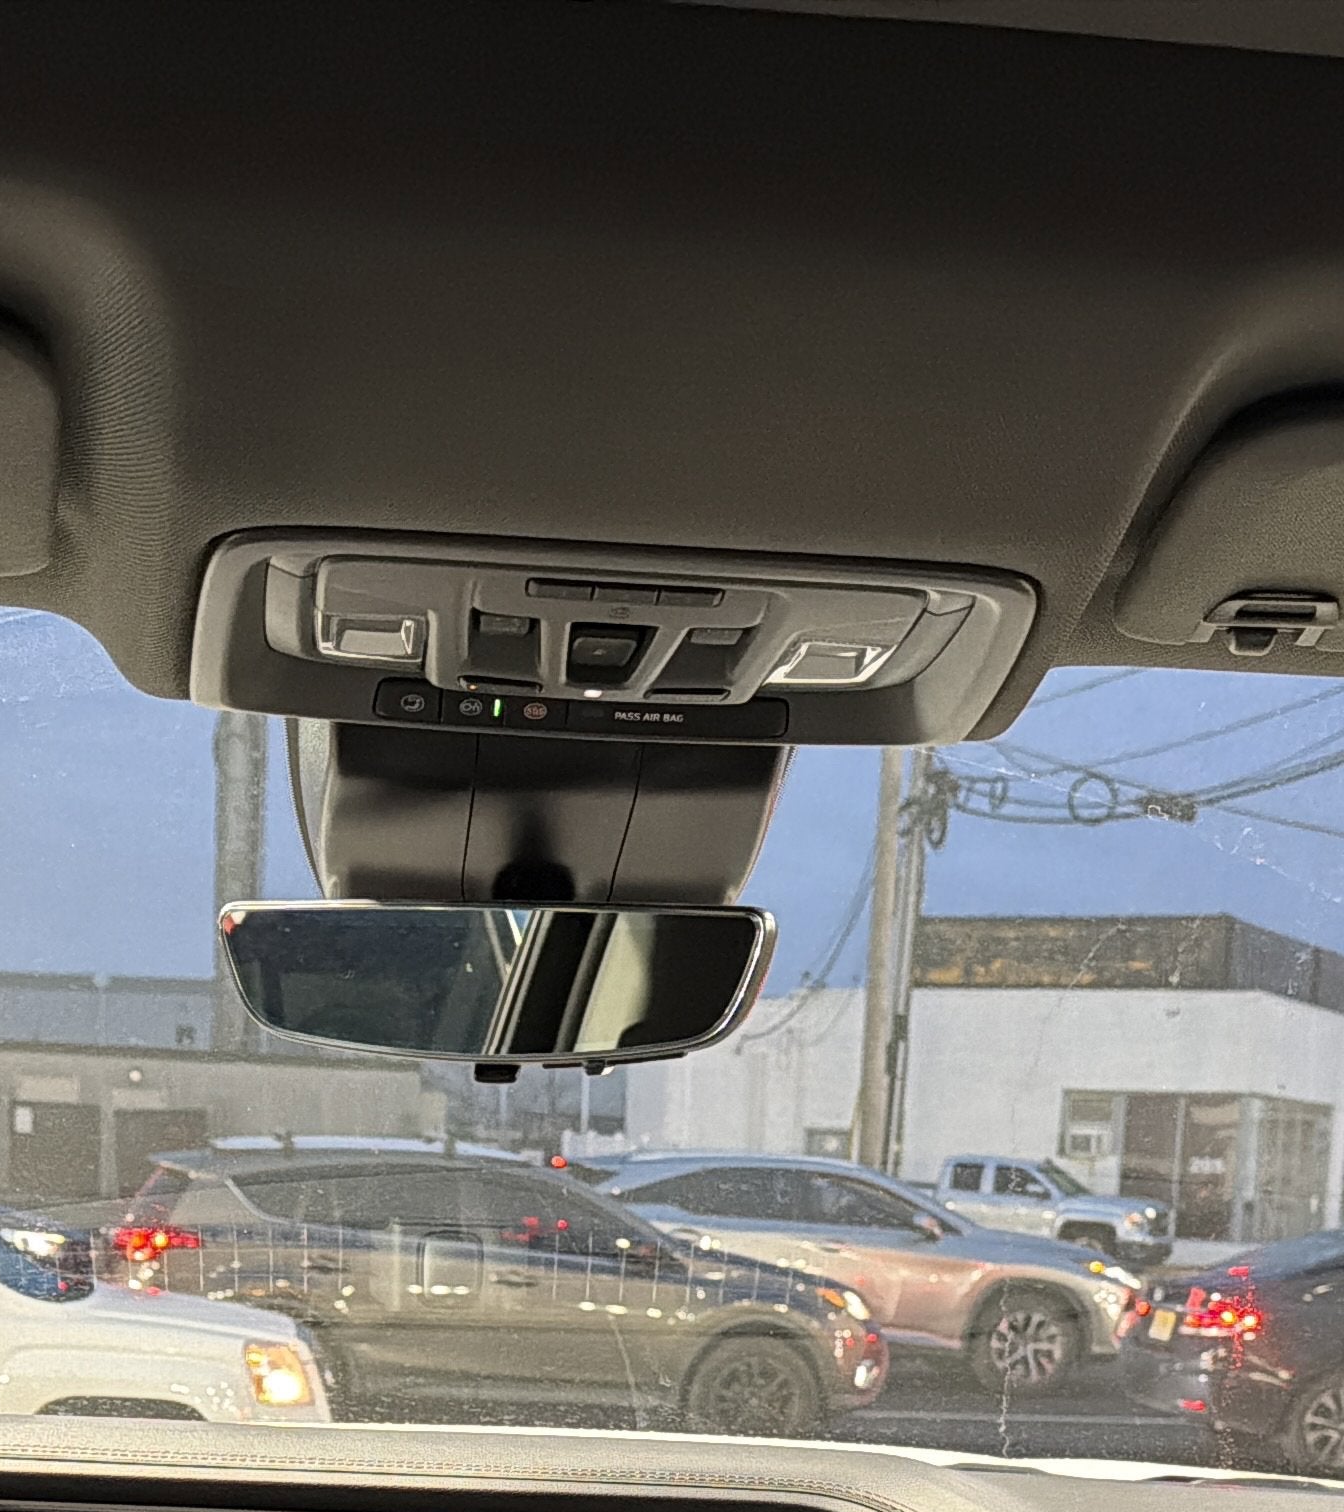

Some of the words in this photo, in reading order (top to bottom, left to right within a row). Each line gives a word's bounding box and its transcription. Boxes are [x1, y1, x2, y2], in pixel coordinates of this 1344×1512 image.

[614, 711, 640, 722] PASS
[643, 713, 661, 722] AIR
[663, 713, 684, 723] BAG
